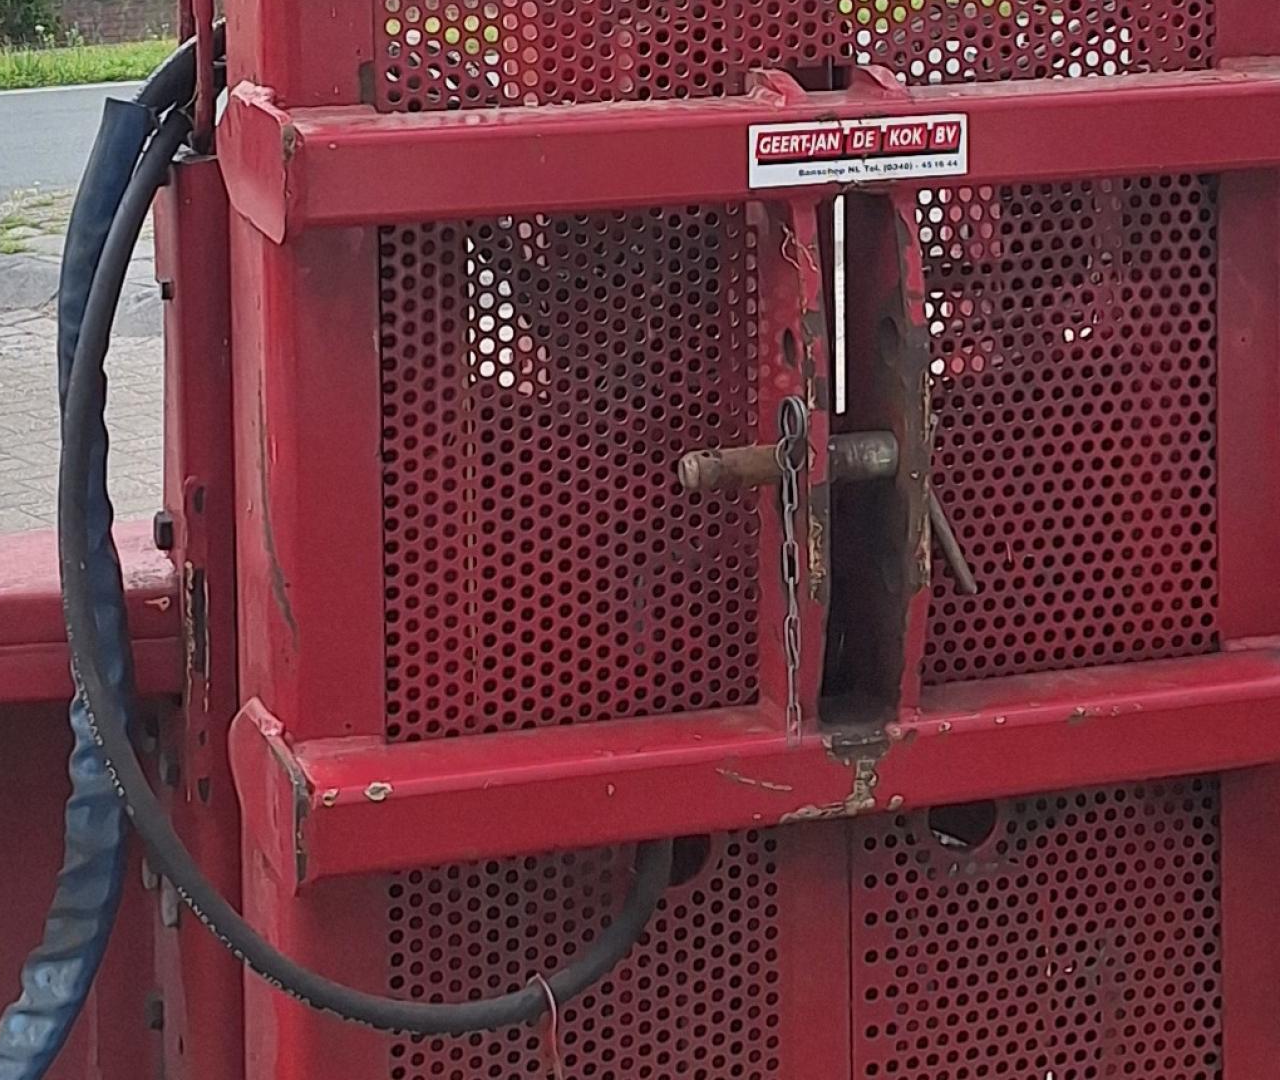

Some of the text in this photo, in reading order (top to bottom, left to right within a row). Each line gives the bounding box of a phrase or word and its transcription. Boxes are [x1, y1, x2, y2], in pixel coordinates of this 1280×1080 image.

[759, 125, 957, 156] GEERT-JAN DE KOK BV
